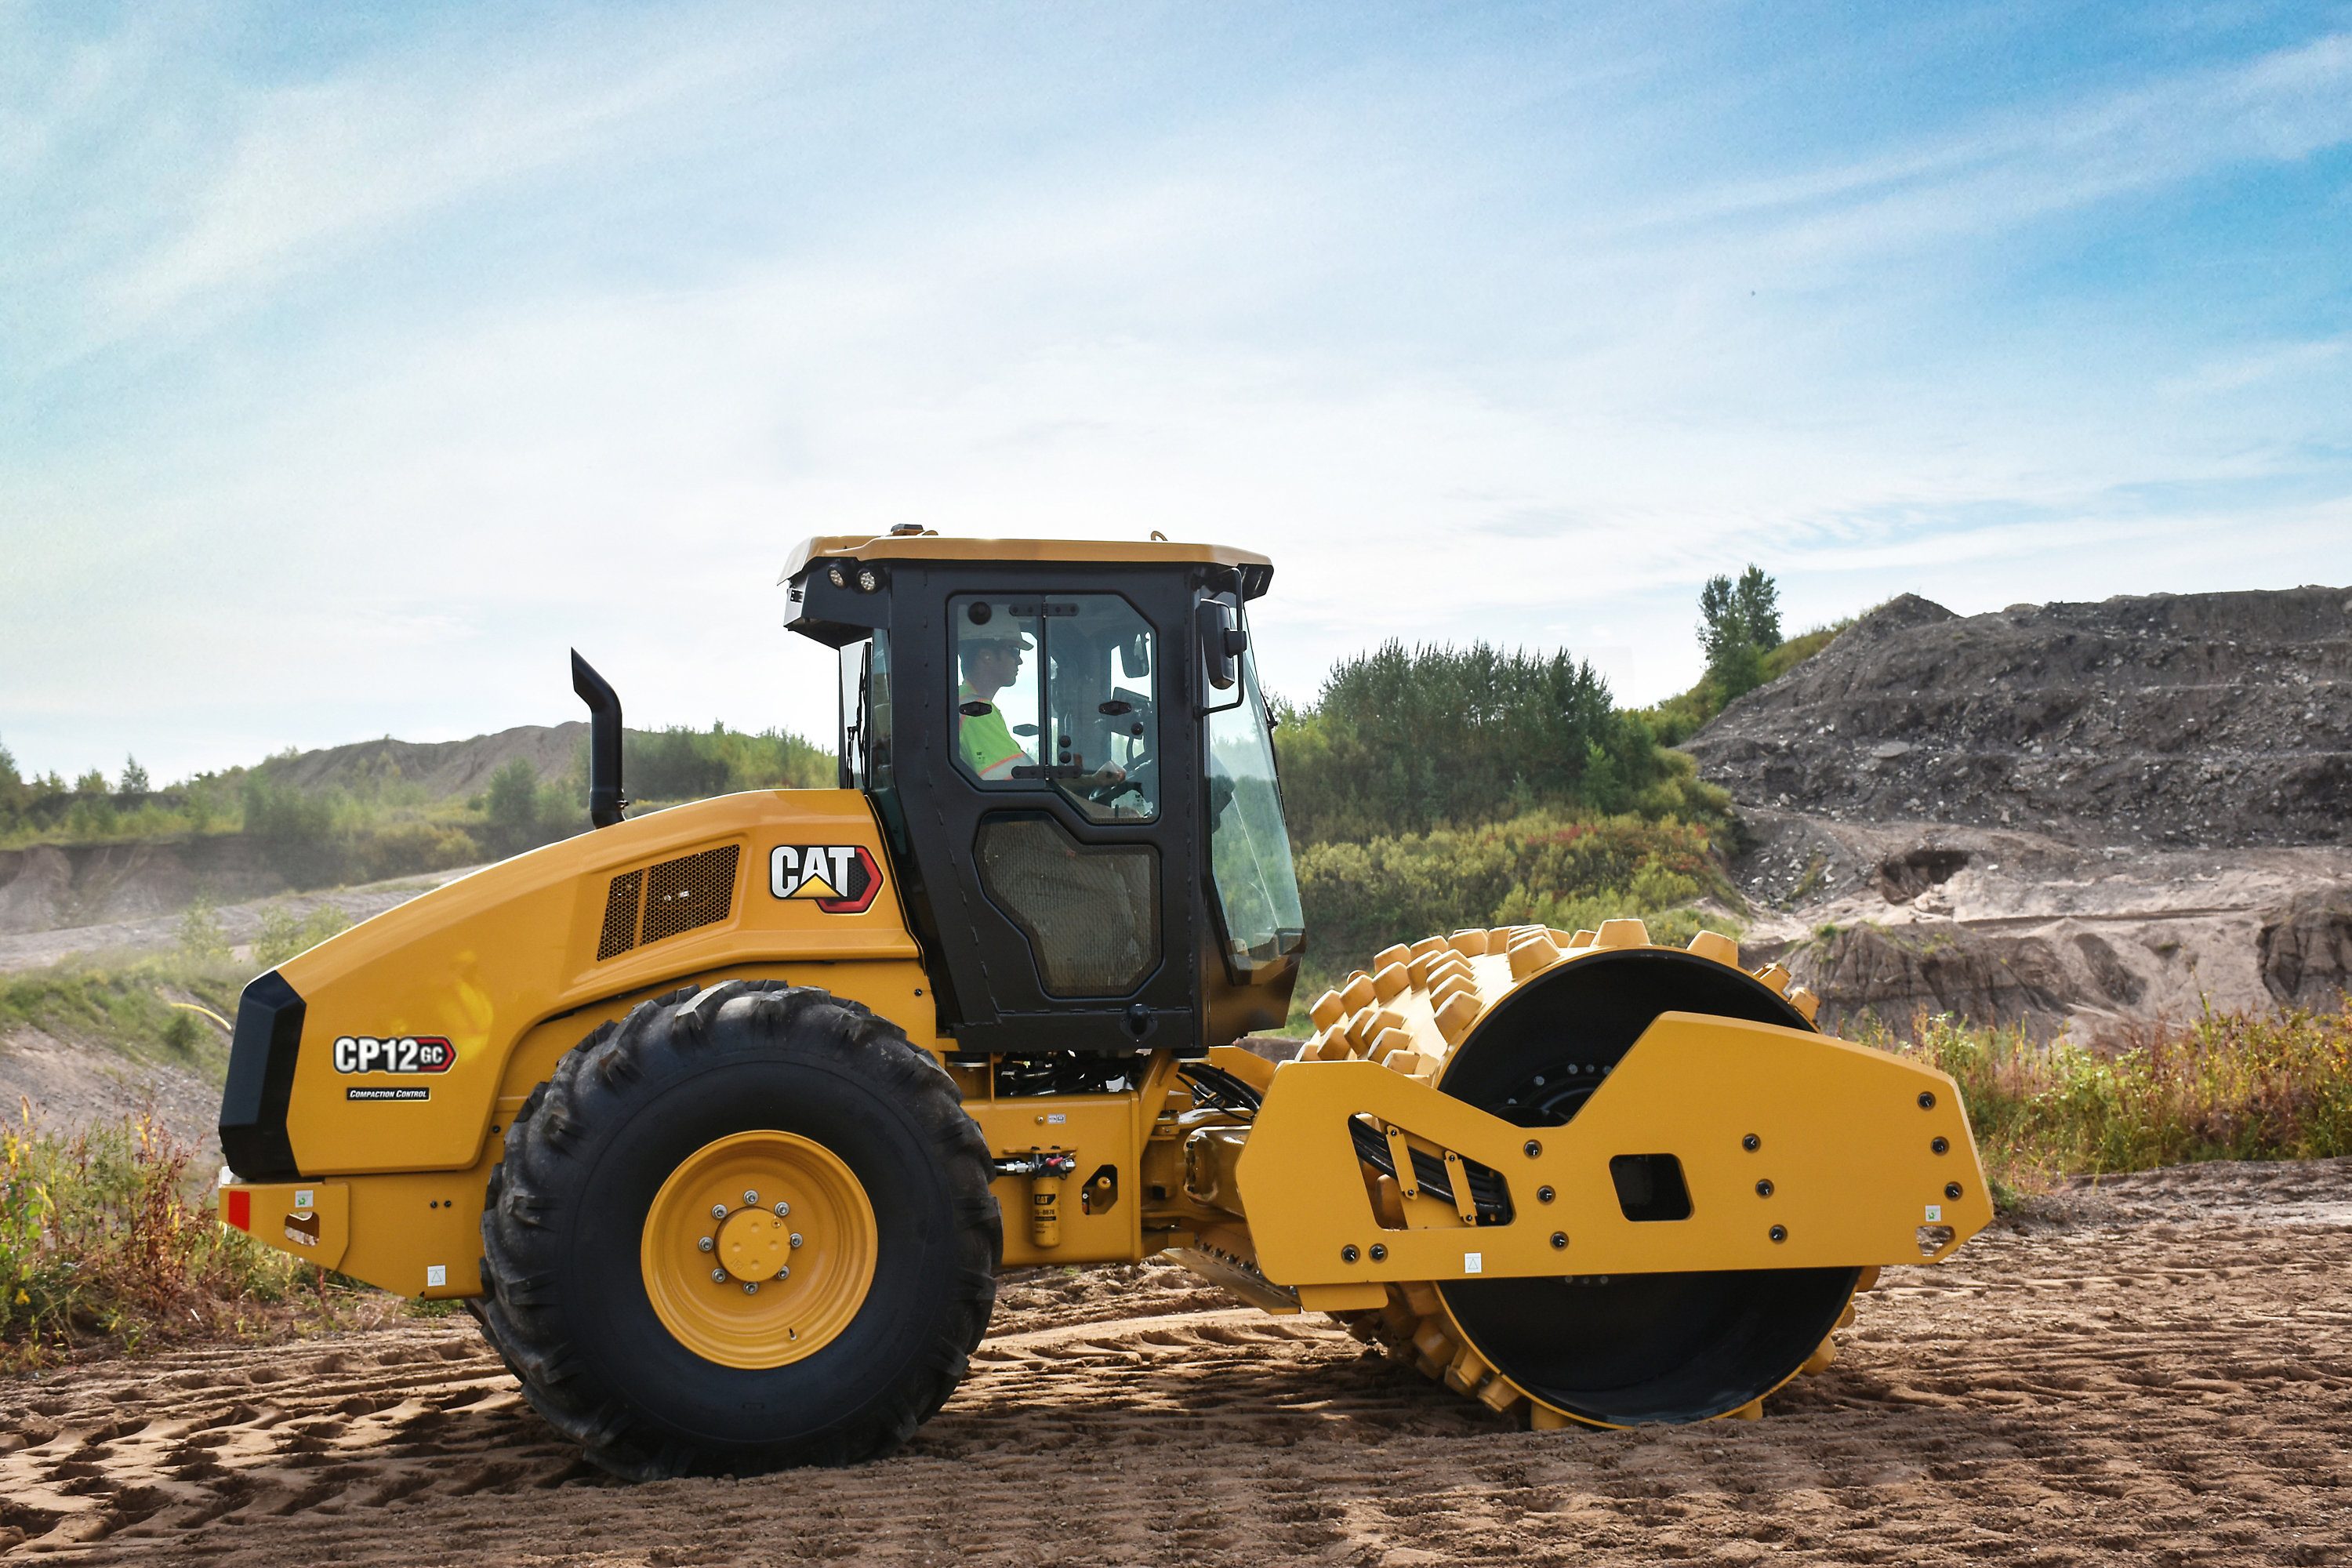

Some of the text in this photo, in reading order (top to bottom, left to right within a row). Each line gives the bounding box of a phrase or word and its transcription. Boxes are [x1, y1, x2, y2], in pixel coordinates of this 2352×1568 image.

[771, 846, 855, 898] CAT
[335, 1037, 444, 1072] CP12 GC
